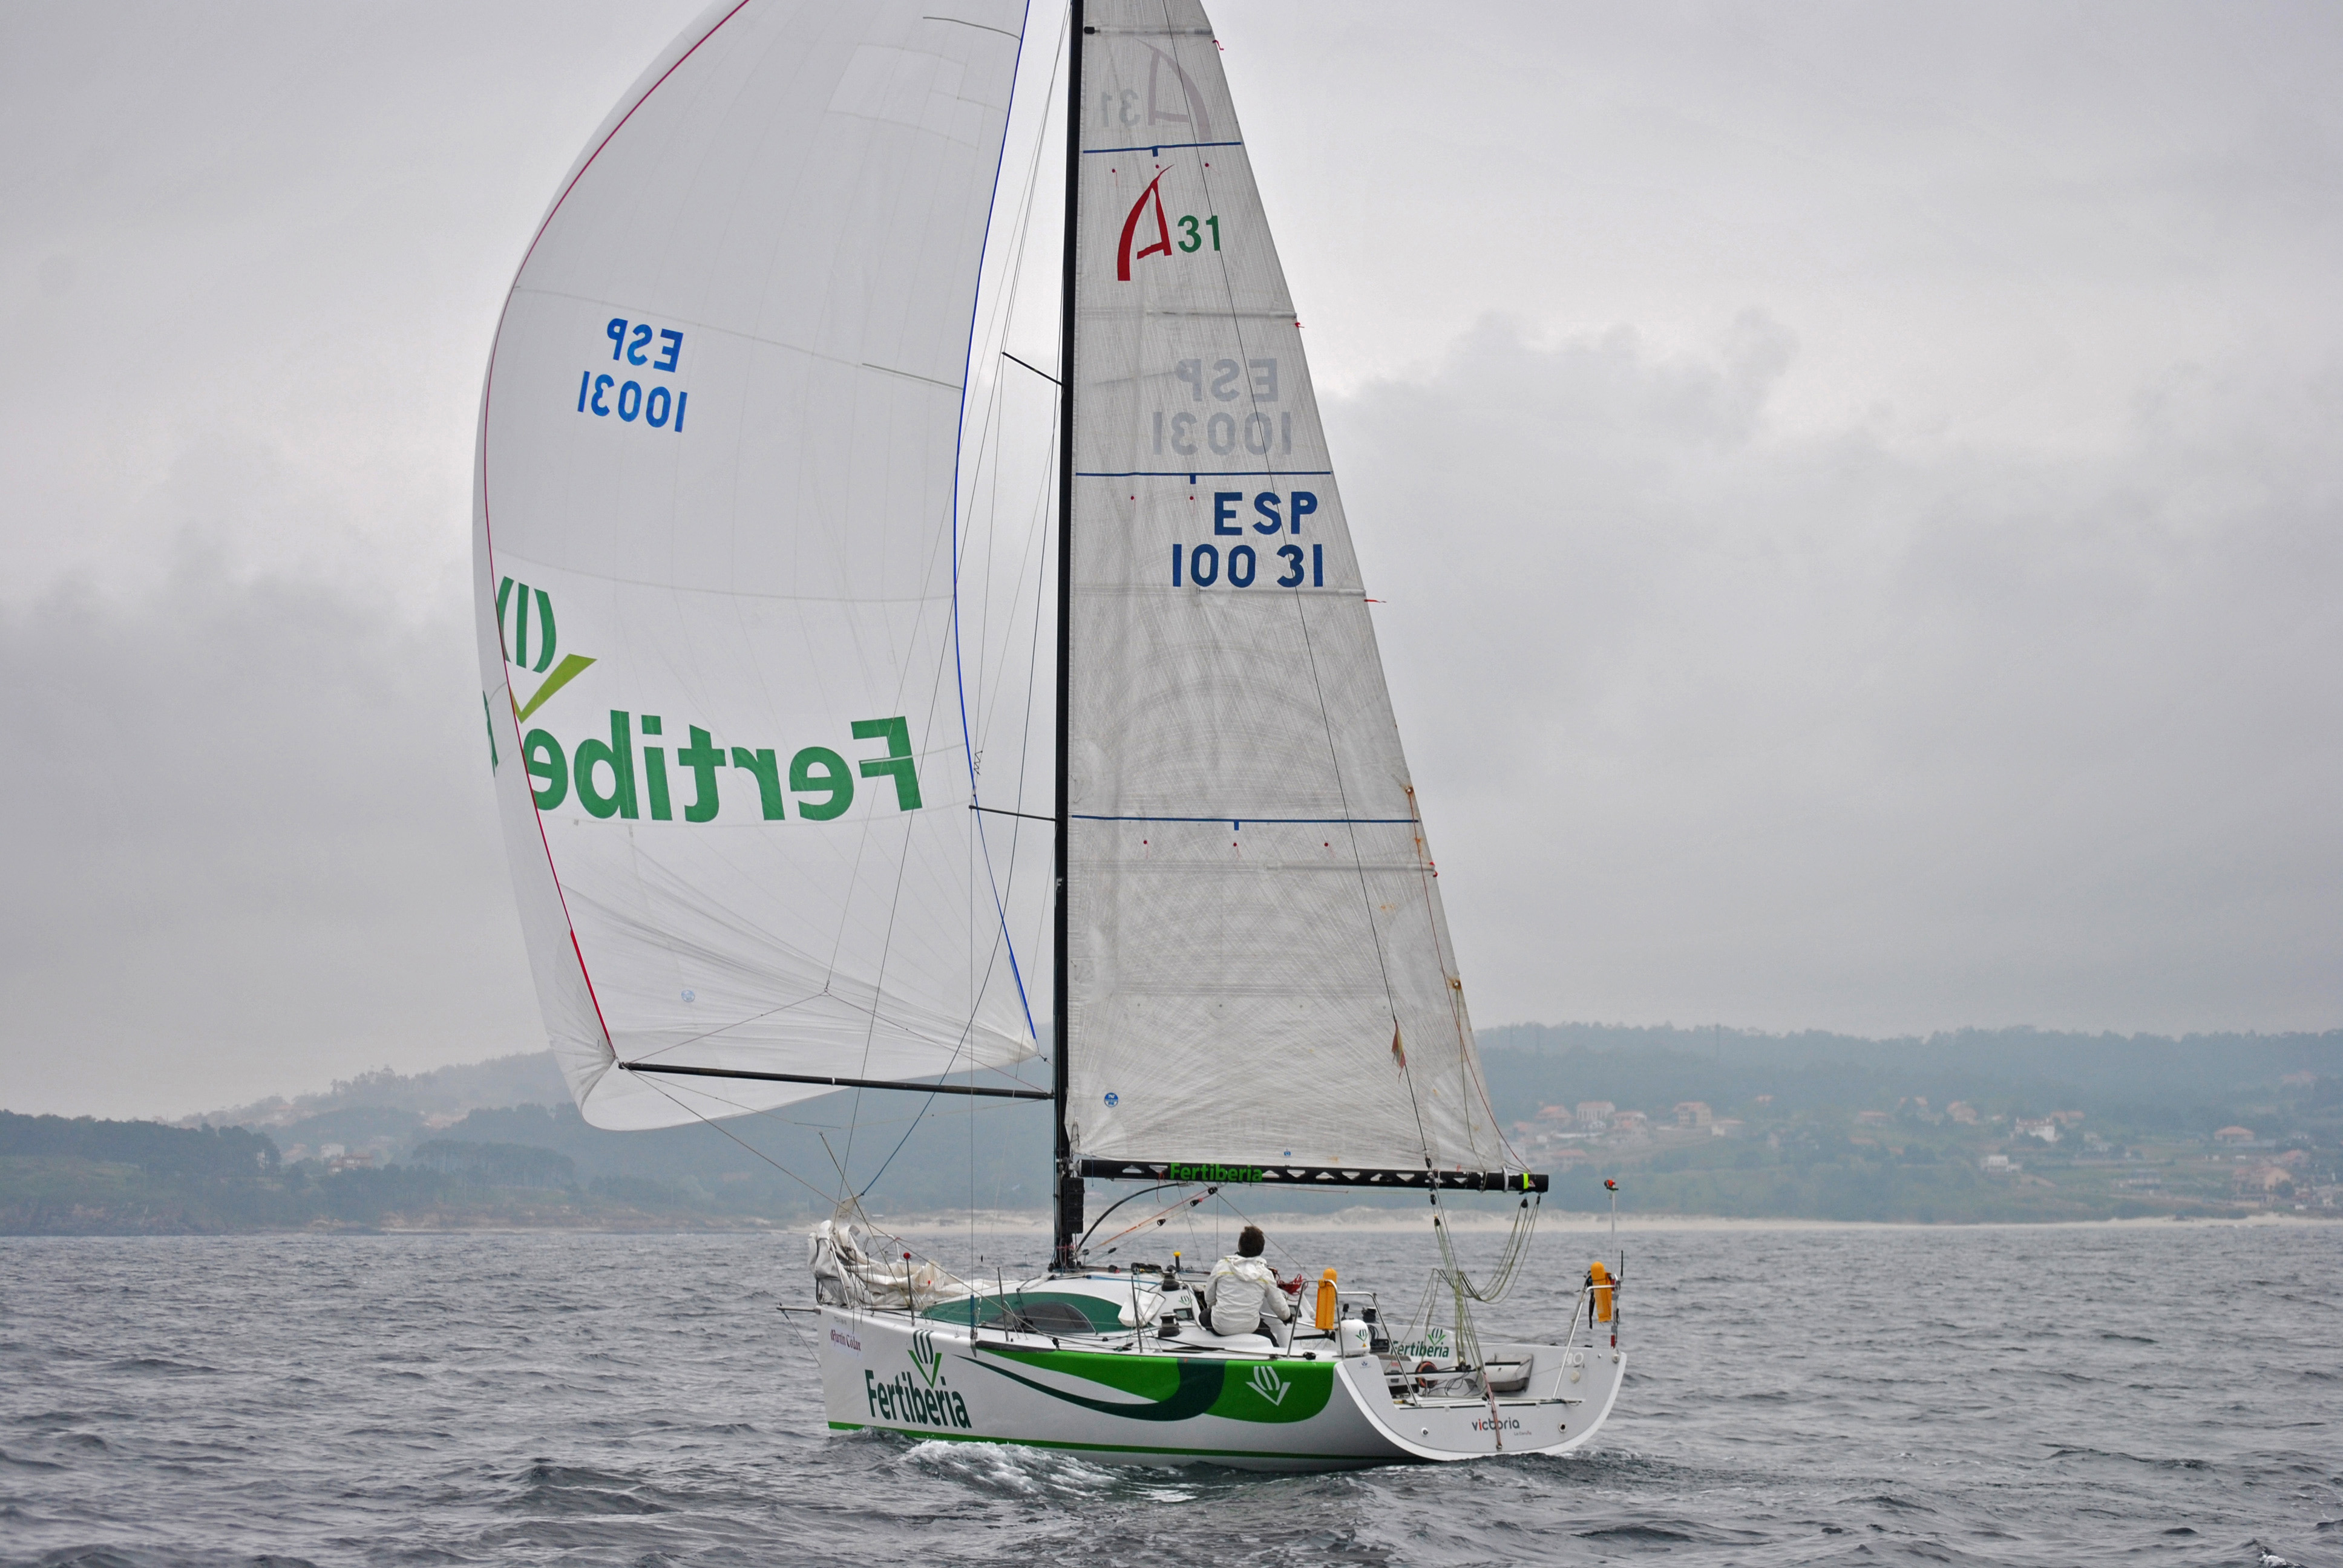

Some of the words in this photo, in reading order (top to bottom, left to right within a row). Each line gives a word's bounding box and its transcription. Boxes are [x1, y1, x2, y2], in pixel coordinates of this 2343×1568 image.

[1178, 215, 1221, 253] 31
[1214, 491, 1318, 536] ESP
[1169, 1161, 1263, 1183] Fertiberia
[865, 1369, 972, 1429] Fertiberia
